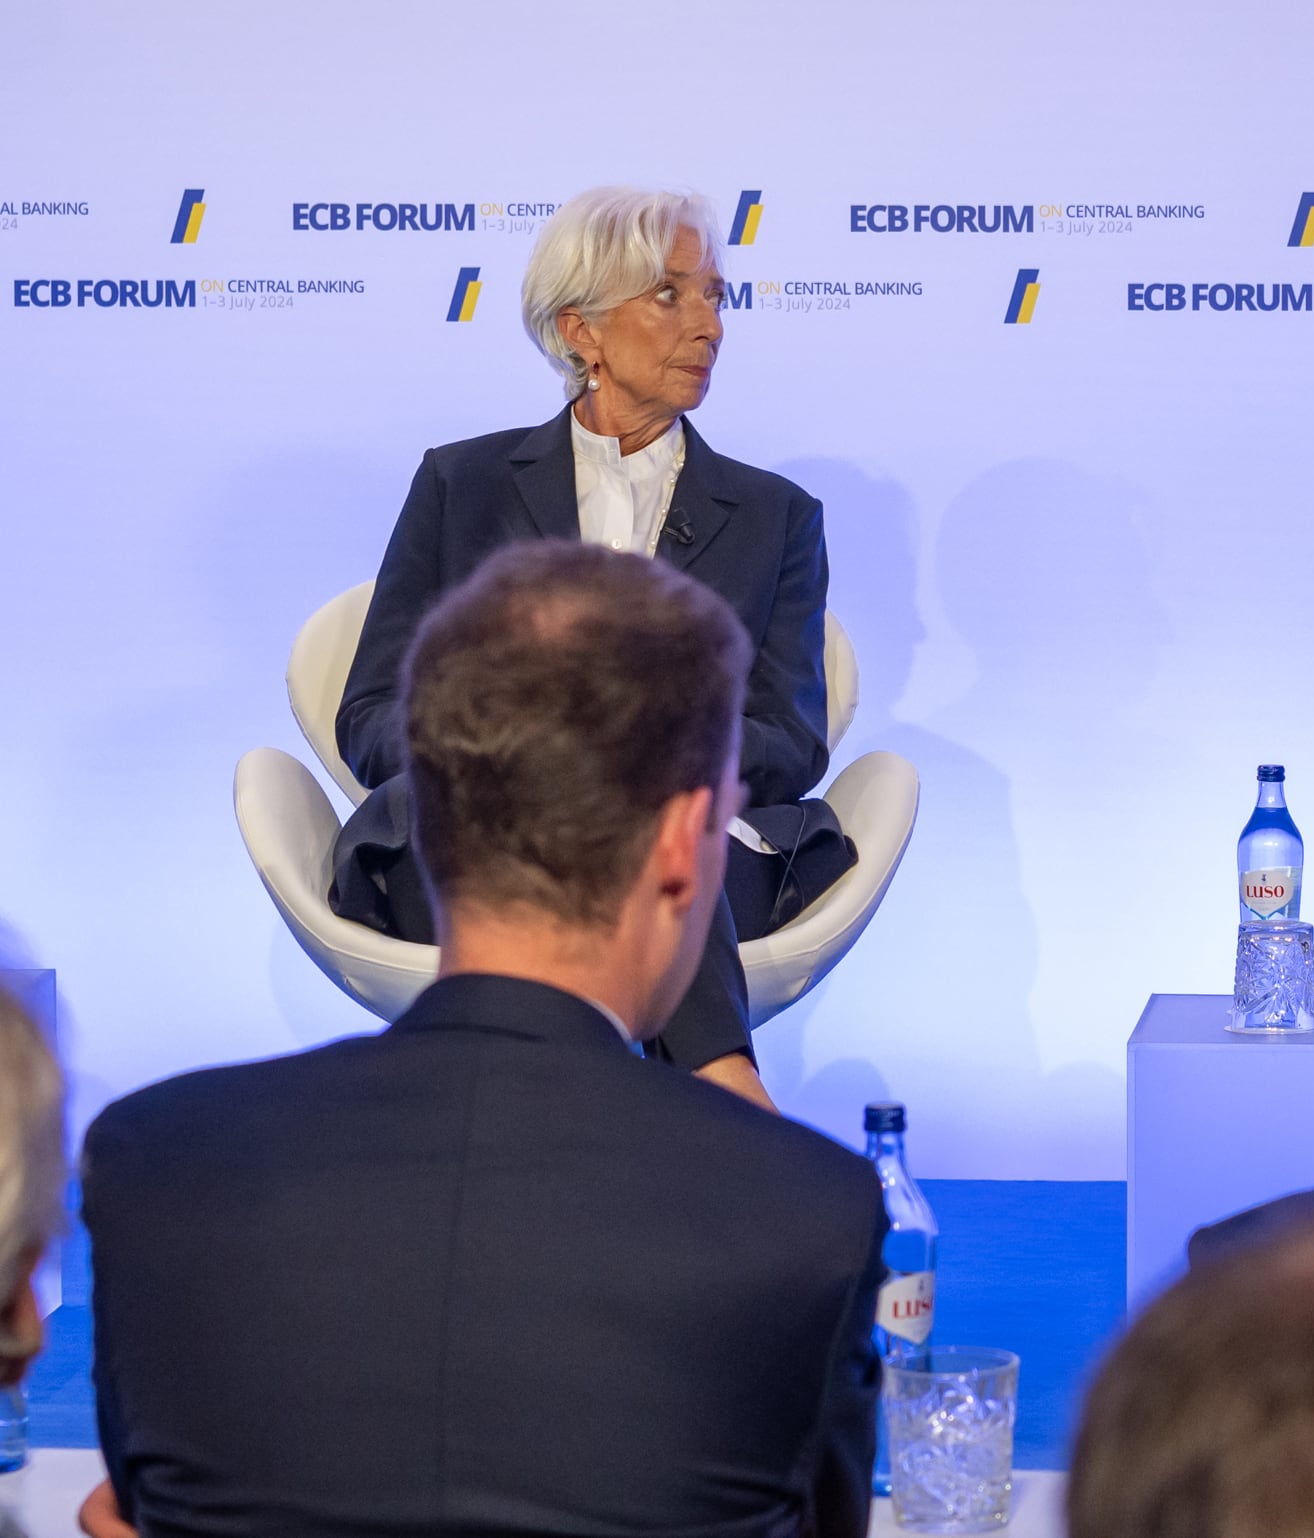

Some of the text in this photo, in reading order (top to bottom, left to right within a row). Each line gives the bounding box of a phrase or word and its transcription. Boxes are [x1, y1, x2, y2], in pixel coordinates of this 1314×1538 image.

[22, 202, 88, 215] BANKING
[293, 203, 562, 231] ECB FORUM ON CENTR
[851, 205, 1204, 232] ECB FORUM ON CENTRAL BANKING
[509, 219, 534, 235] July
[1067, 221, 1093, 236] July
[1098, 221, 1132, 233] 2024
[14, 280, 365, 307] ECB FORUM ON CENTRAL BANKING
[757, 281, 922, 295] ON CENTRAL BANKING
[229, 296, 255, 311] July
[260, 295, 294, 308] 2024
[786, 297, 812, 313] July
[816, 297, 851, 310] 2024
[1128, 283, 1186, 311] ECB
[1192, 283, 1312, 311] FORUM
[1246, 885, 1285, 898] LUSO
